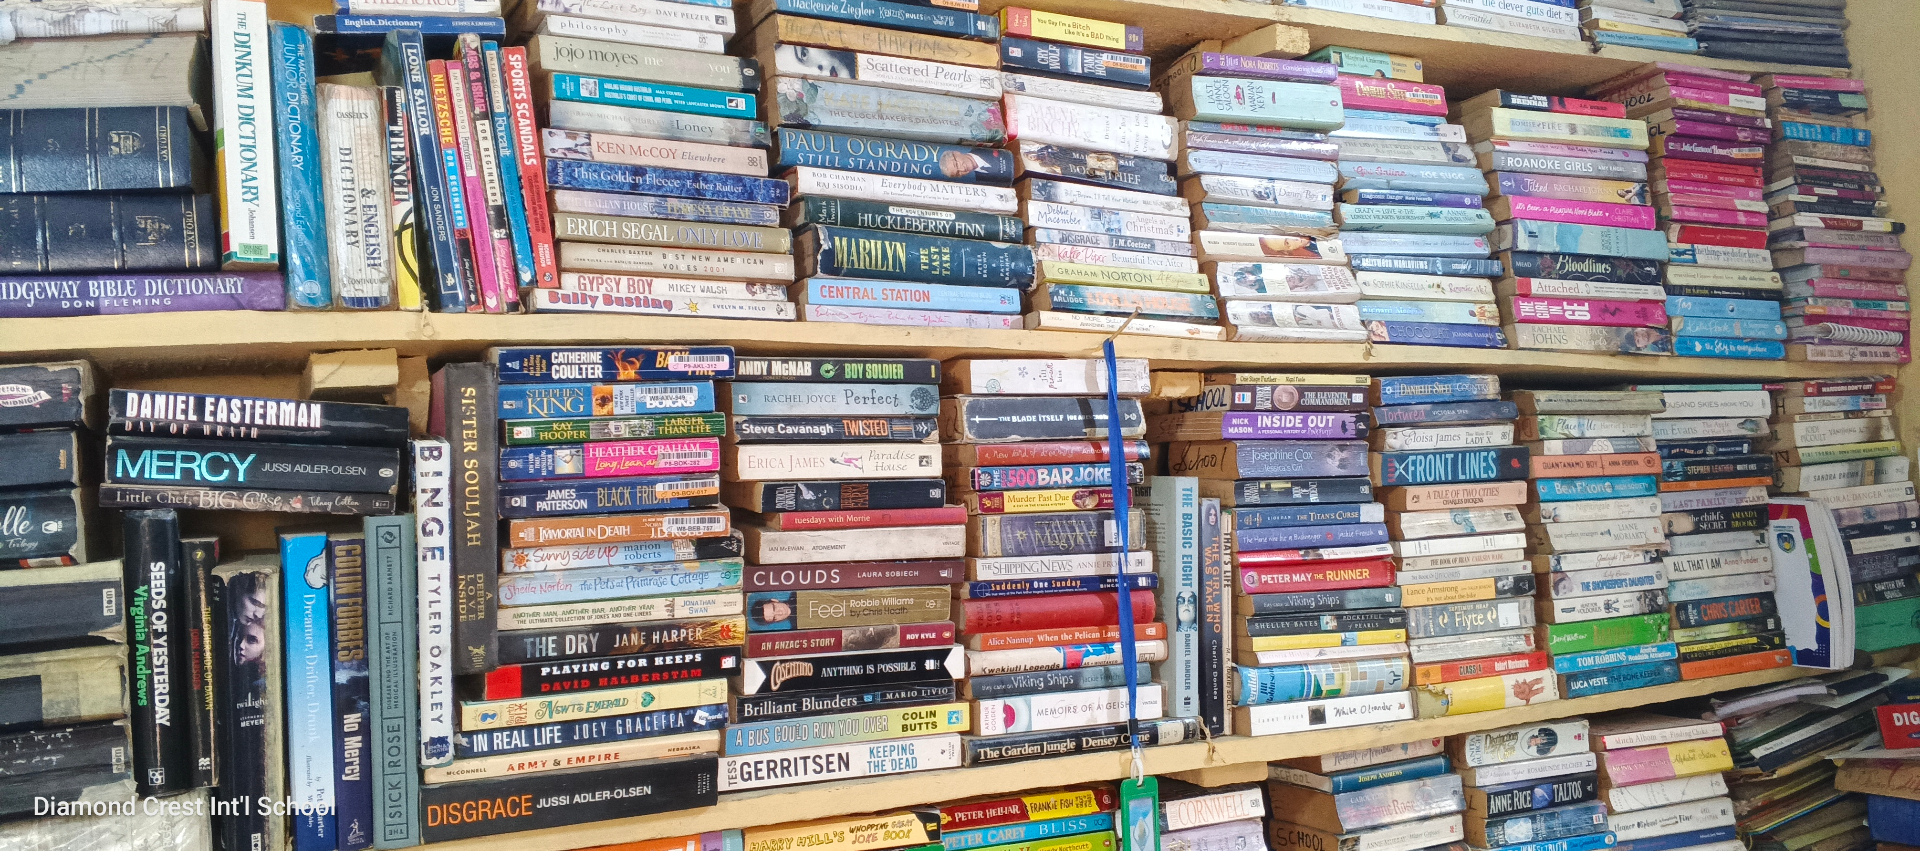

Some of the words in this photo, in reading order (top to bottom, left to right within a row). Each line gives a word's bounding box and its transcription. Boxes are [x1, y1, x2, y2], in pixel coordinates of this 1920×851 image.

[236, 12, 246, 29] THE
[1498, 2, 1524, 10] clever
[1527, 4, 1544, 16] guts
[1547, 8, 1562, 19] diet
[560, 21, 629, 35] philosophy
[234, 30, 254, 98] DINKUM
[407, 48, 420, 83] LONE
[553, 42, 584, 62] jojo
[589, 49, 638, 65] moyes
[509, 54, 526, 100] SPORTS
[866, 57, 929, 75] Scattered
[935, 67, 972, 83] Pearls
[413, 89, 429, 136] SAILOR
[432, 74, 453, 144] NIETZSCHE
[158, 126, 167, 160] OXFORD
[515, 102, 537, 166] SCANDALS
[237, 104, 260, 207] DICTIONARY
[596, 142, 626, 155] KEN
[630, 145, 677, 159] McCOY
[681, 152, 725, 164] Elsewhere
[785, 131, 839, 153] PAUL
[847, 137, 940, 163] O'GRADY
[797, 153, 845, 168] STILL
[849, 159, 933, 176] STANDING
[1508, 157, 1560, 170] ROANOKE
[1565, 161, 1593, 172] GIRLS
[361, 188, 376, 198] &
[574, 168, 598, 179] This
[601, 170, 642, 184] Golden
[646, 172, 680, 188] Fleece
[687, 176, 714, 189] Esther
[716, 182, 743, 194] Rutter
[338, 147, 360, 249] DICTIONARY
[186, 210, 195, 248] OXFORD
[362, 203, 382, 267] ENGLISH
[567, 218, 617, 237] ERICH
[622, 222, 673, 241] SEGAL
[677, 226, 719, 245] ONLY
[722, 230, 762, 247] LOVE
[858, 213, 951, 235] HUCKLEBERRY
[955, 223, 985, 237] FINN
[834, 237, 906, 273] MARILYN
[921, 247, 929, 270] THE
[1557, 255, 1611, 274] Bloodlines
[578, 275, 621, 293] GYPSY
[627, 278, 653, 295] BOY
[669, 283, 696, 293] MIKEY
[700, 285, 727, 295] WALSH
[1057, 268, 1098, 277] GRAHAM
[1101, 271, 1153, 283] NORTON
[0, 281, 81, 307] IDGEWAY
[89, 280, 136, 296] BIBLE
[144, 278, 244, 295] DICTIONARY
[548, 291, 598, 308] Bully
[603, 294, 673, 311] Busting
[820, 285, 876, 300] CENTRAL
[882, 288, 930, 302] STATION
[1537, 283, 1583, 294] Attached.
[62, 300, 94, 308] DON
[104, 298, 172, 306] FLEMING
[1532, 326, 1565, 334] RACHAEL
[1532, 333, 1568, 345] JOHNS
[552, 352, 602, 364] CATHERINE
[738, 361, 768, 375] ANDY
[772, 362, 812, 376] McNAB
[844, 363, 863, 378] BOY
[866, 363, 903, 379] SOLDIER
[552, 364, 602, 379] COULTER
[526, 388, 584, 398] STEPHEN
[126, 392, 197, 421] DANIEL
[204, 396, 321, 428] EASTERMAN
[461, 387, 478, 453] SISTER
[528, 398, 585, 417] KING
[1382, 408, 1426, 420] Tortured
[742, 424, 774, 434] Steve
[777, 424, 833, 435] Cavanagh
[842, 420, 888, 436] TWISTED
[1258, 416, 1303, 427] INSIDE
[1308, 416, 1335, 427] OUT
[116, 449, 256, 482] MERCY
[262, 463, 291, 472] JUSSI
[293, 464, 366, 475] ADLER-OLSEN
[1408, 453, 1454, 482] FRONT
[1458, 451, 1497, 479] LINES
[419, 445, 445, 562] BINGE
[462, 458, 481, 547] SOULJAH
[536, 499, 587, 510] PATTERSON
[545, 489, 576, 499] JAMES
[335, 545, 361, 594] COLIN
[754, 569, 840, 586] CLOUDS
[1261, 574, 1290, 583] PETER
[1292, 573, 1312, 582] MAY
[1327, 569, 1370, 581] RUNNER
[151, 562, 167, 609] SEEDS
[130, 585, 150, 641] Virginia
[427, 573, 442, 636] TYLER
[1701, 602, 1726, 620] CHRIS
[1728, 598, 1762, 616] CARTER
[152, 612, 167, 634] OF
[337, 599, 363, 662] FORBES
[524, 637, 558, 658] THE
[566, 632, 599, 655] DRY
[614, 630, 647, 647] JANE
[652, 628, 703, 643] HARPER
[541, 661, 610, 676] PLAYING
[617, 658, 648, 669] FOR
[655, 653, 702, 665] KEEPS
[1577, 656, 1595, 666] TOM
[1596, 653, 1626, 665] ROBBINS
[135, 643, 151, 706] Andrews
[153, 634, 171, 727] YESTERDAY
[429, 645, 444, 724] OAKLEY
[1571, 680, 1587, 689] LUCA
[1589, 677, 1608, 688] VESTE
[744, 700, 797, 717] Brilliant
[802, 695, 858, 711] Blunders
[343, 713, 361, 732] No
[473, 734, 488, 752] IN
[493, 731, 530, 750] REAL
[534, 727, 562, 745] LIFE
[573, 722, 606, 740] JOEY
[616, 715, 684, 734] GRACEFFA
[343, 736, 362, 781] Mercy
[388, 723, 400, 769] ROSE
[978, 749, 999, 759] The
[1002, 745, 1040, 755] Garden
[1043, 741, 1076, 753] Jungle
[740, 752, 850, 782] GERRITSEN
[1358, 773, 1377, 782] JOSEPH
[388, 780, 403, 818] SICK
[426, 795, 533, 827] DISGRACE
[536, 797, 569, 808] JUSSI
[573, 786, 651, 804] ADLER-OLSEN
[1490, 794, 1512, 811] ANNE
[1513, 790, 1531, 808] RICE
[1553, 783, 1582, 801] TALTOS
